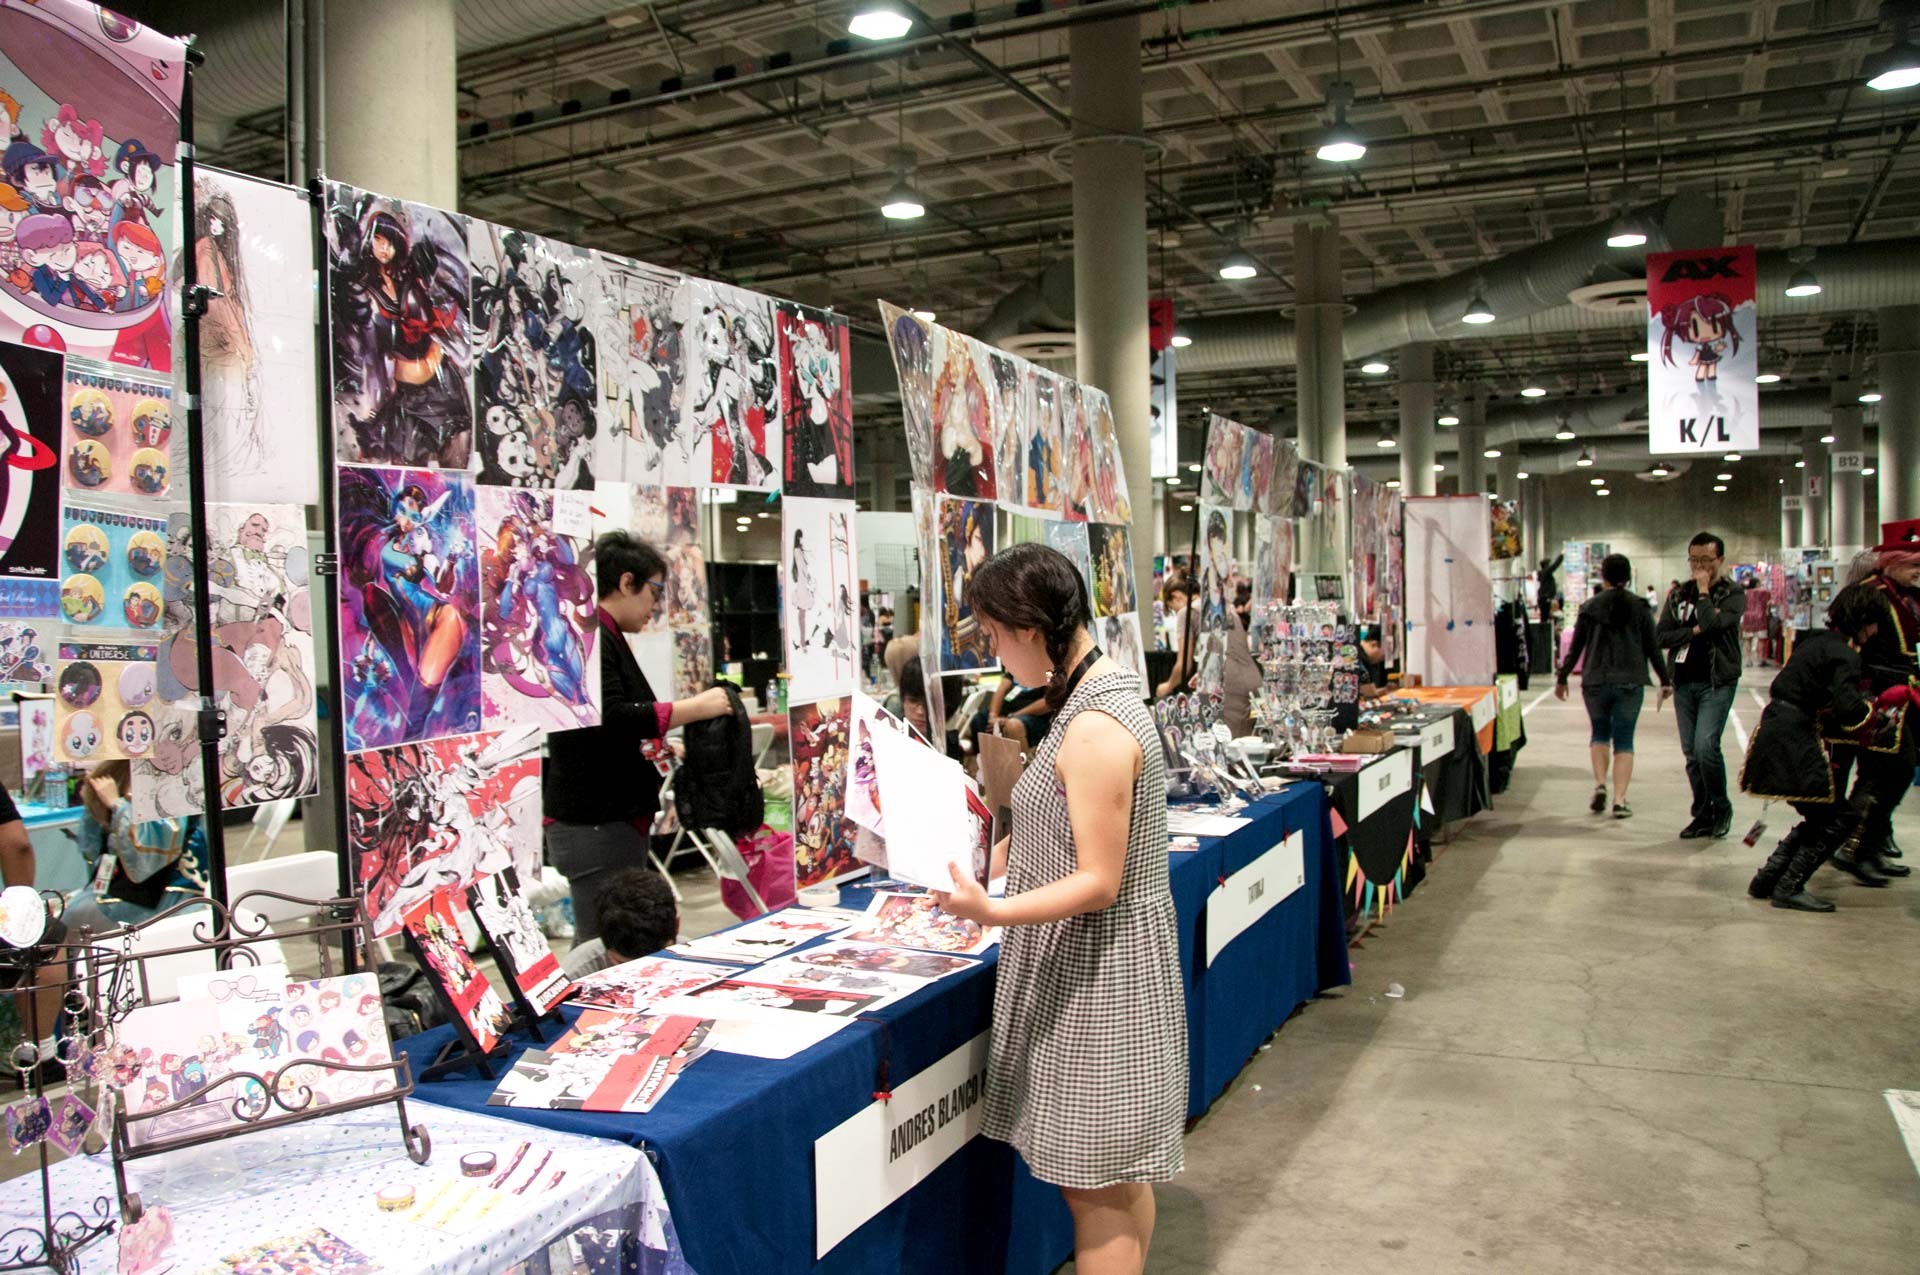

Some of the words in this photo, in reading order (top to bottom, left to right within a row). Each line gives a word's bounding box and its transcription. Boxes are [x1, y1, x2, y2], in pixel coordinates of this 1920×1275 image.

[1662, 256, 1743, 282] AX
[1680, 414, 1730, 448] K/L
[1839, 456, 1859, 467] B12
[889, 1103, 936, 1164] ANDRES
[938, 1074, 978, 1130] BLANCO
